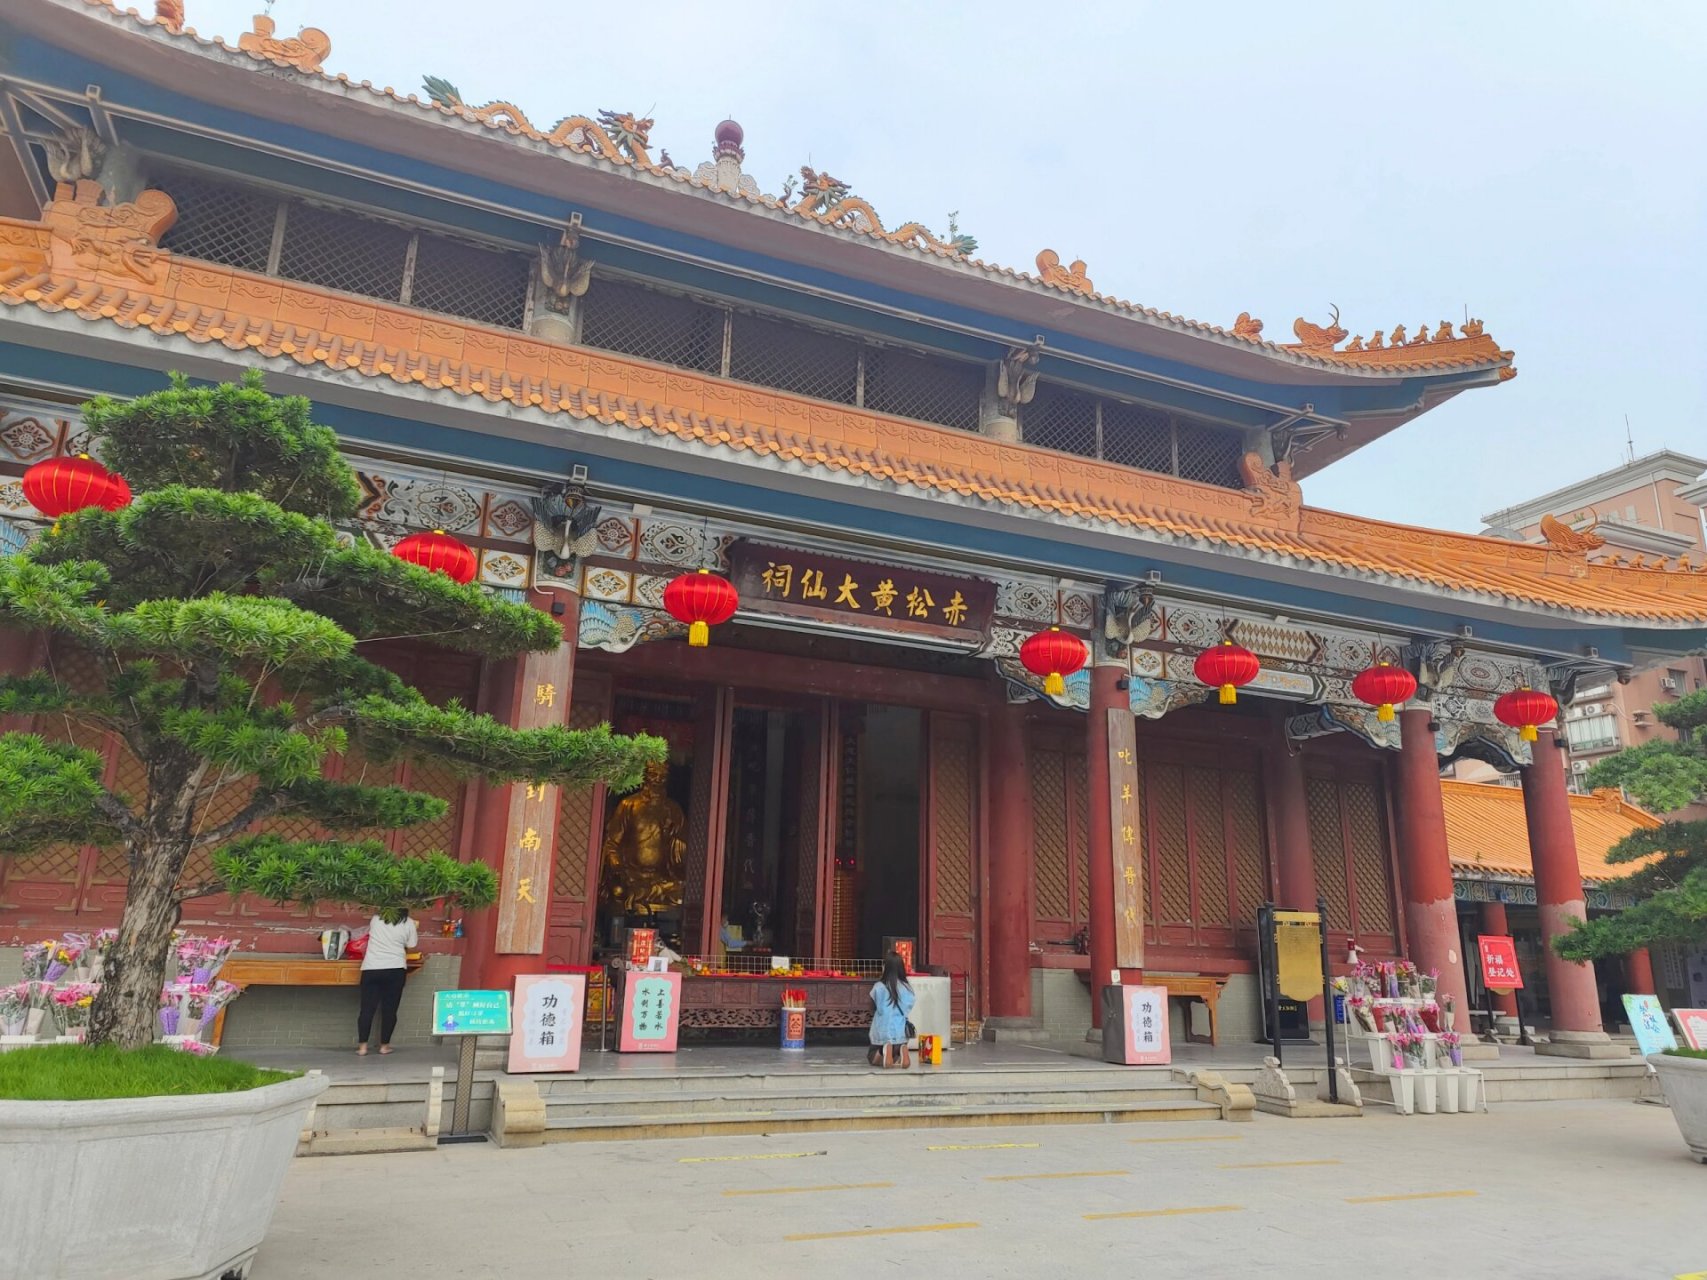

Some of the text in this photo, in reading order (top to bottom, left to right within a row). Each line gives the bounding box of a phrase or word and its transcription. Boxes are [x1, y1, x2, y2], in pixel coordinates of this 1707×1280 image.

[761, 561, 968, 626] 赤松黄大仙祠
[515, 682, 557, 904] 騎到南天
[1486, 953, 1504, 965] 祈福
[1488, 967, 1515, 978] 登记处
[538, 993, 558, 1046] 功德箱
[654, 989, 665, 1031] 上善若水
[1141, 1001, 1153, 1043] 功德箱
